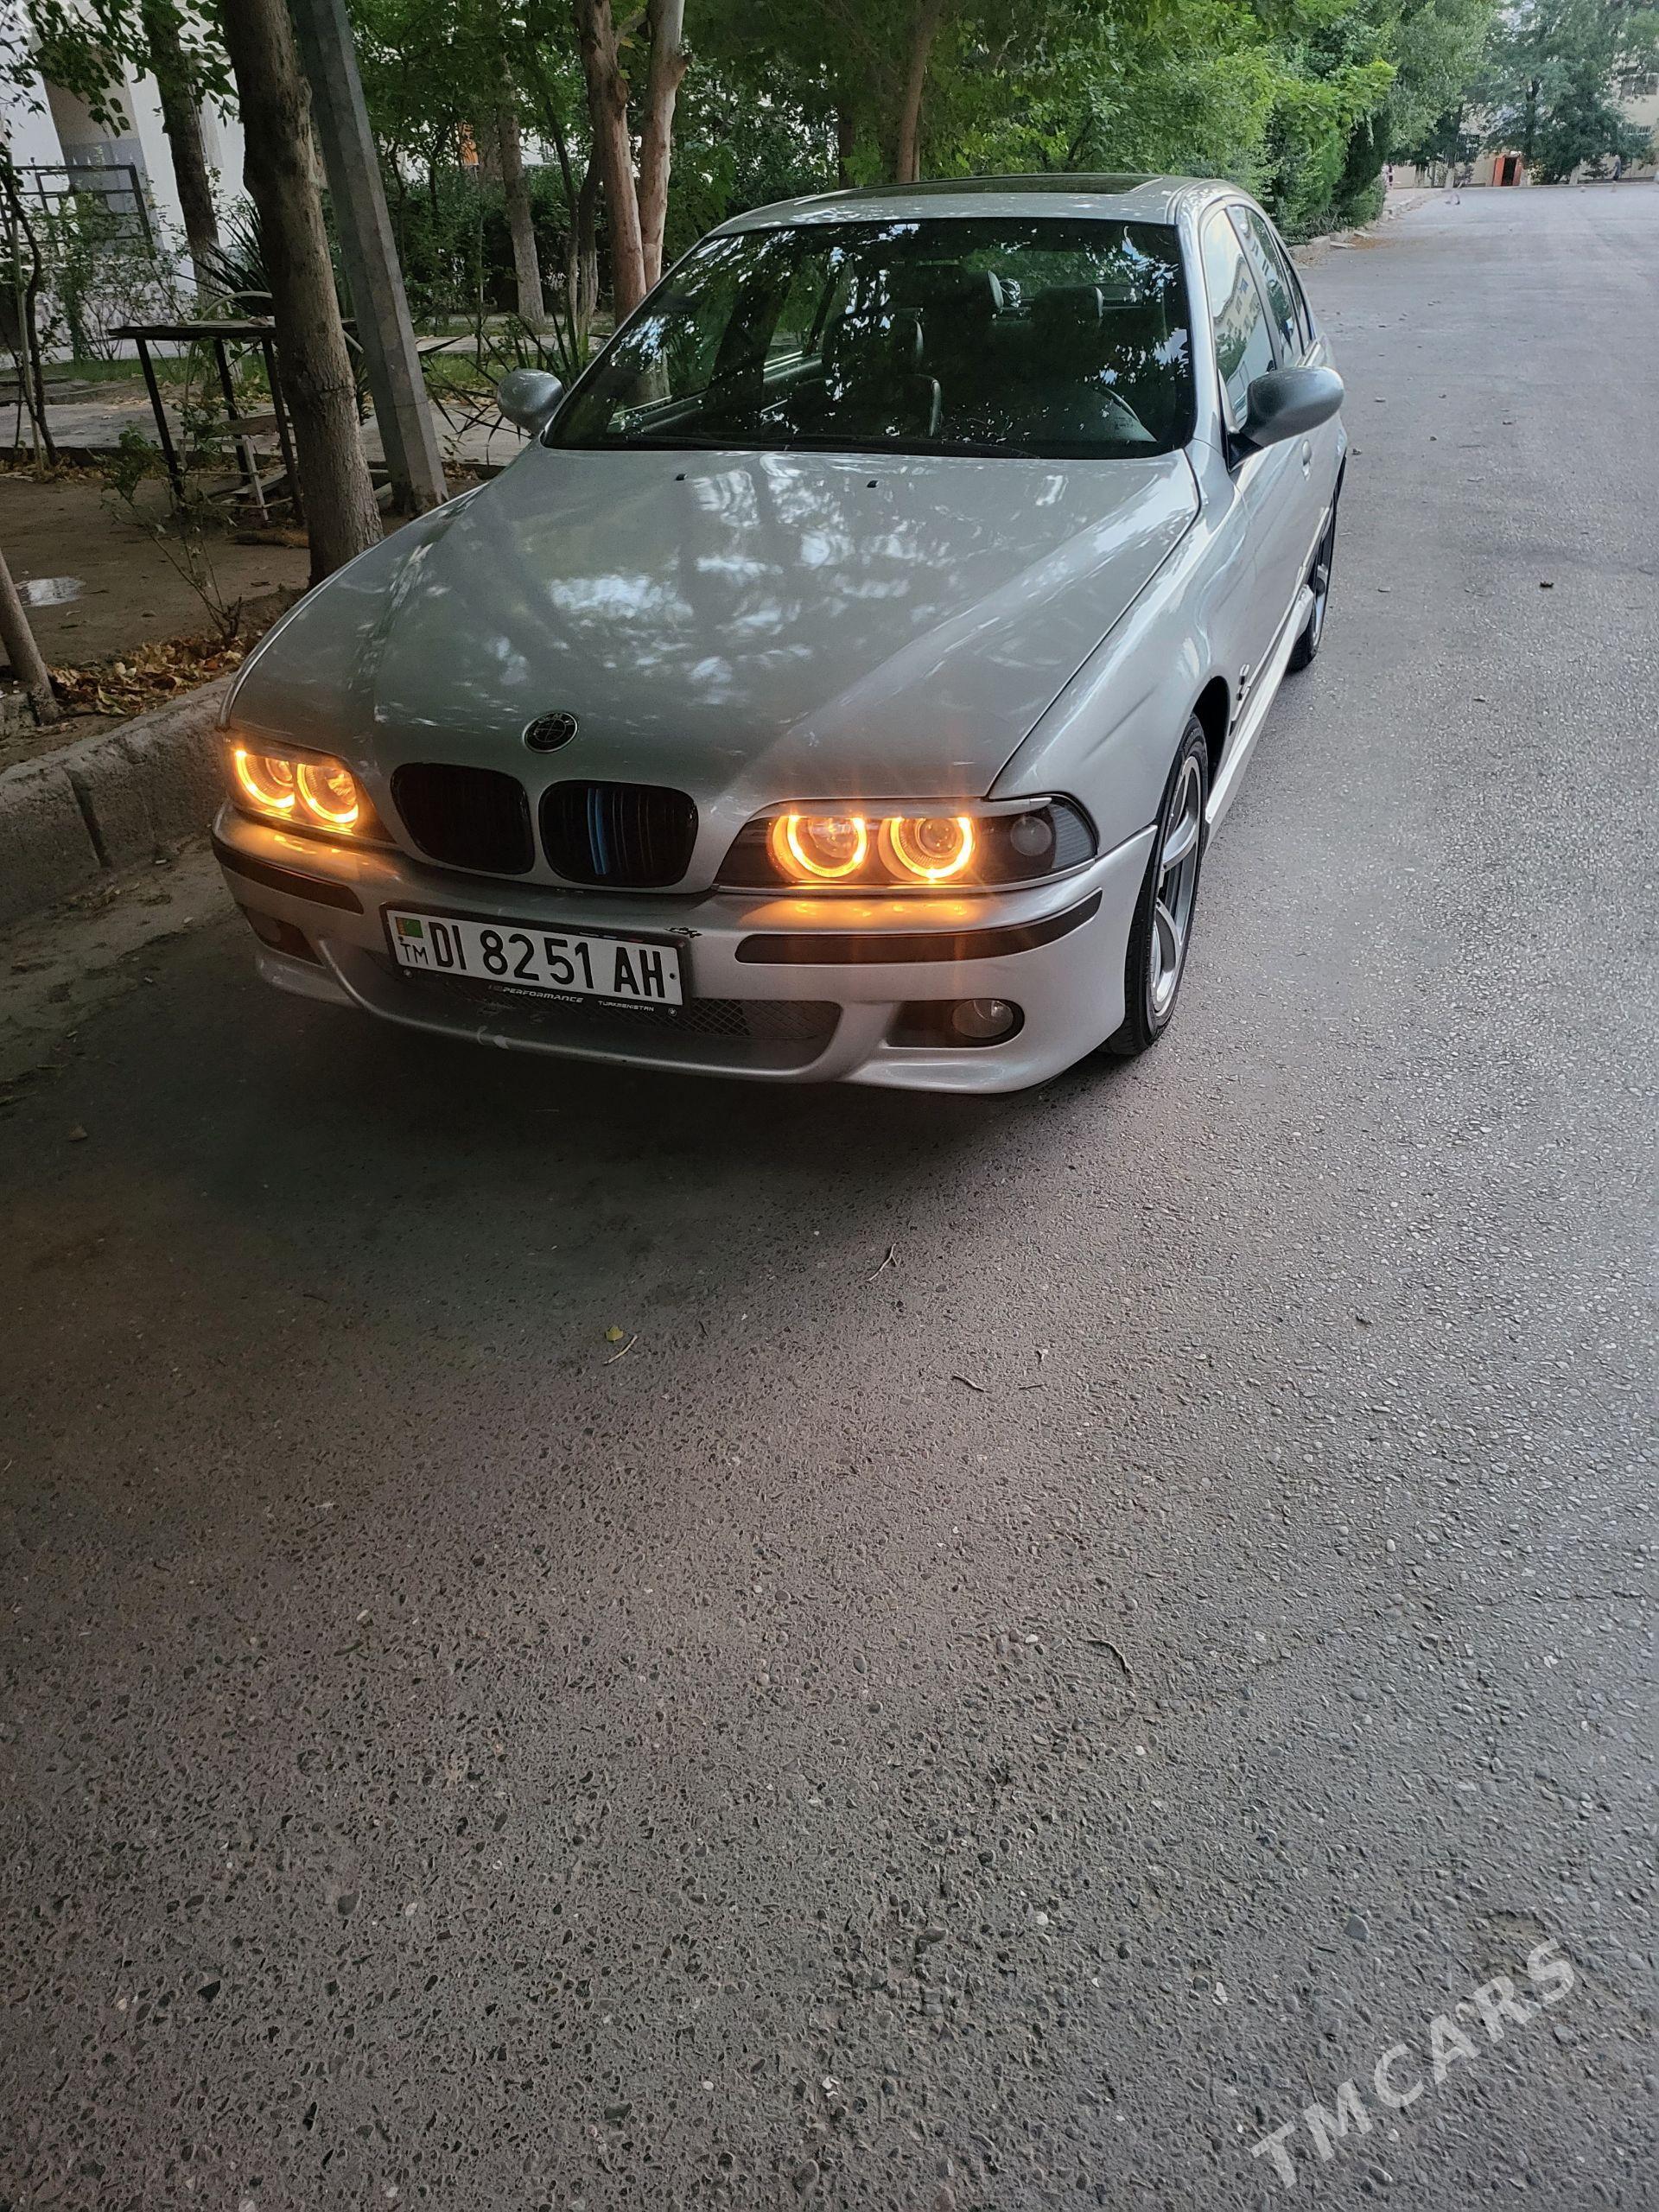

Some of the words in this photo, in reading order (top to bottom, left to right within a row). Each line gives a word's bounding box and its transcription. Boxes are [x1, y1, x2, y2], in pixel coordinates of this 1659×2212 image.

[400, 943, 429, 965] TM
[428, 921, 467, 970] DI
[480, 929, 594, 989] 8251
[613, 946, 665, 998] AH
[502, 987, 584, 1003] PERFORMANCE
[597, 1000, 655, 1012] TURKMENISTAN
